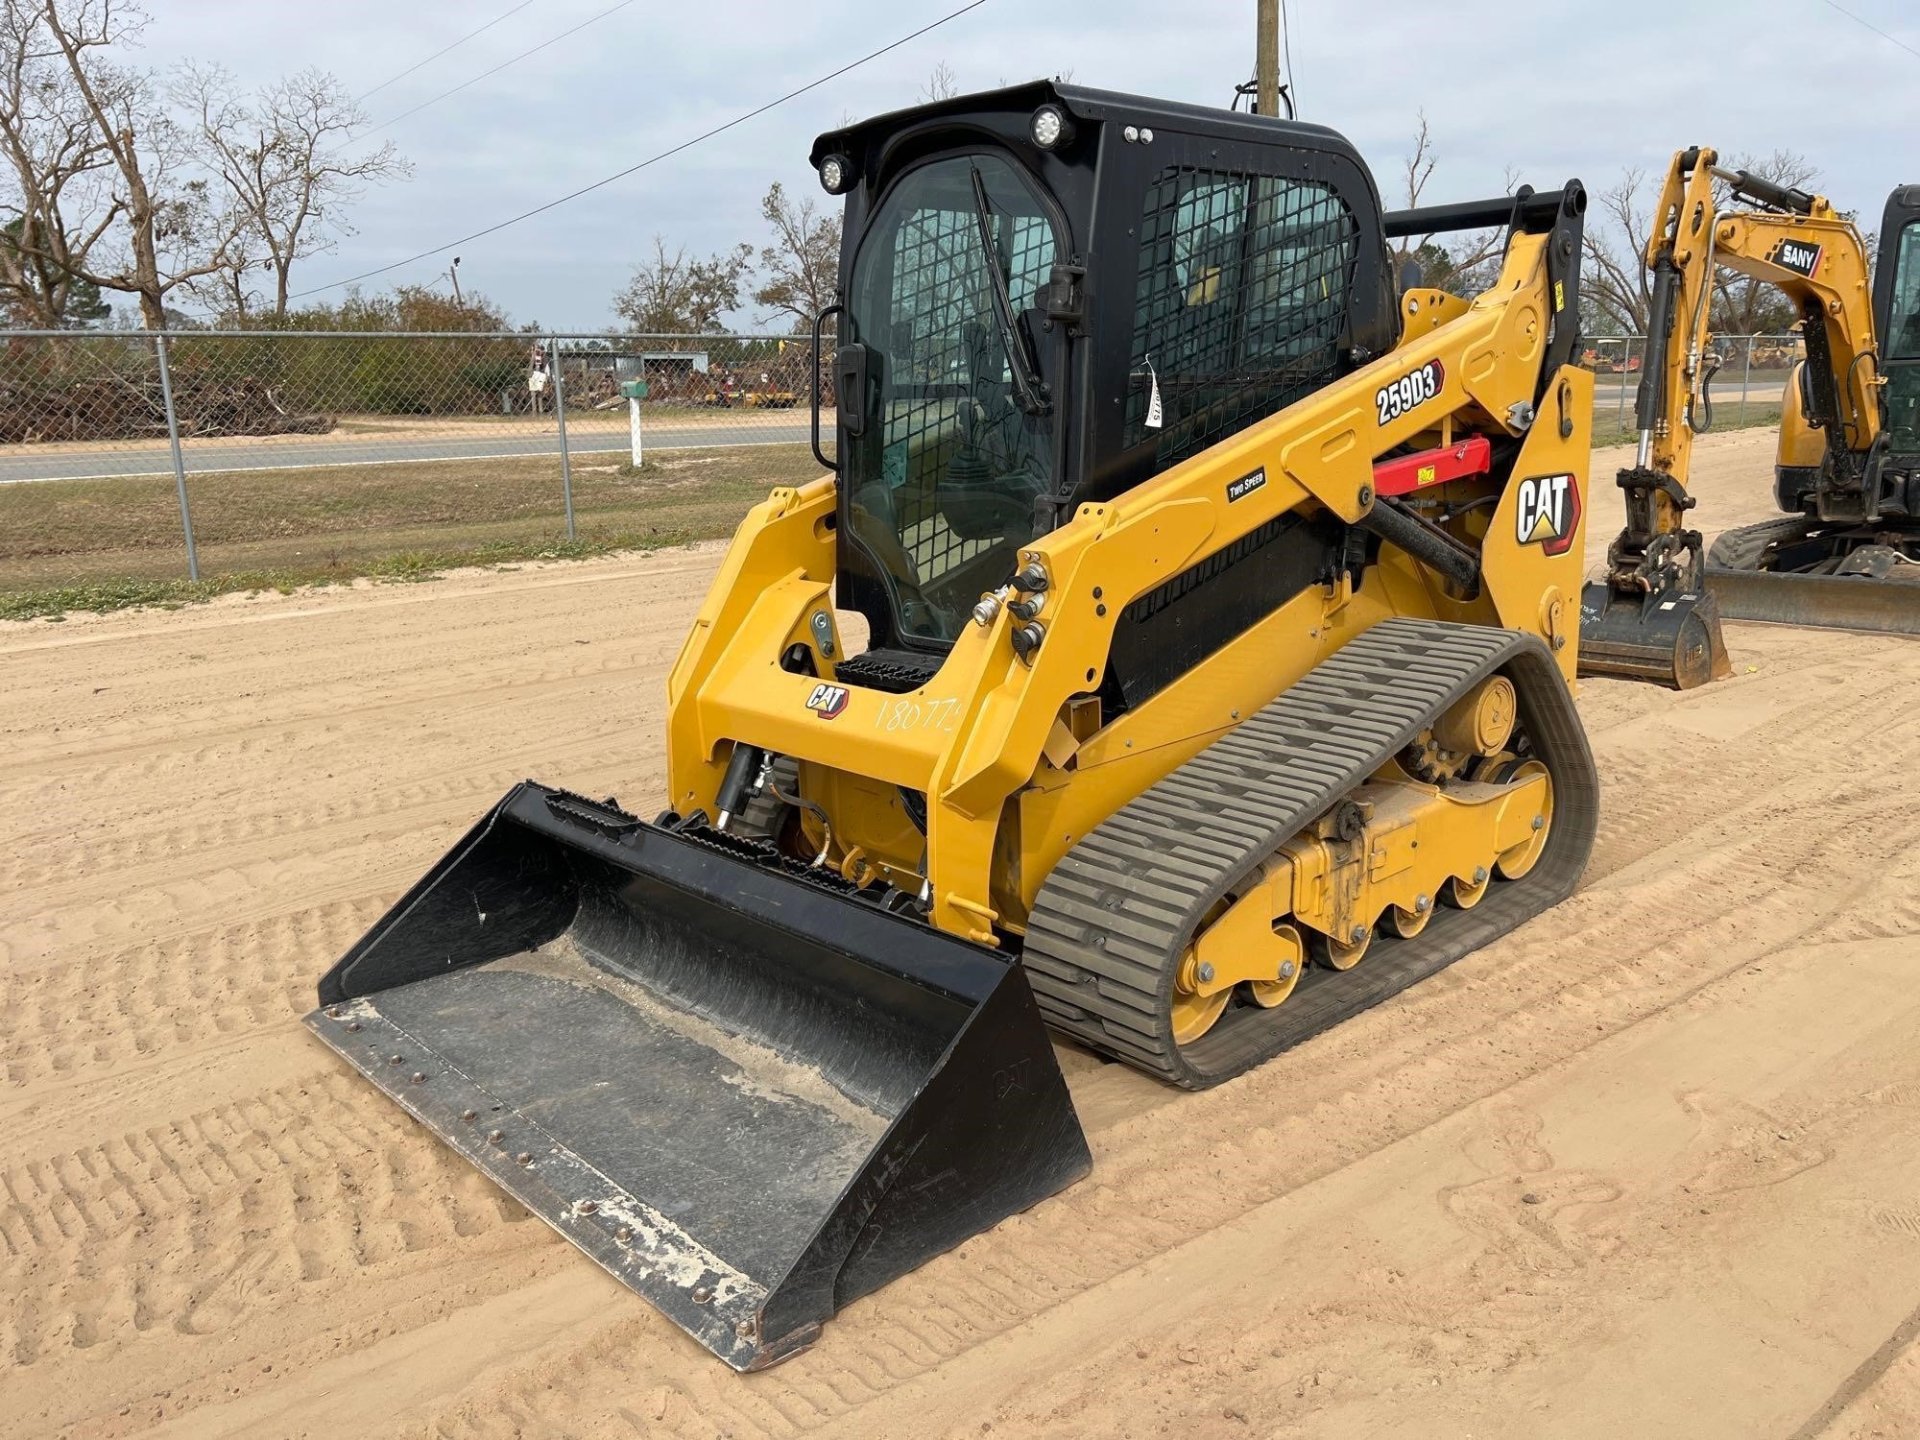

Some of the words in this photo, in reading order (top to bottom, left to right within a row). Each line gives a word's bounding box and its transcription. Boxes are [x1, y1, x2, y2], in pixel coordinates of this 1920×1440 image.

[1783, 244, 1815, 269] SANY
[1377, 364, 1435, 425] 259D3
[1517, 475, 1569, 543] CAT
[806, 684, 846, 712] CAT
